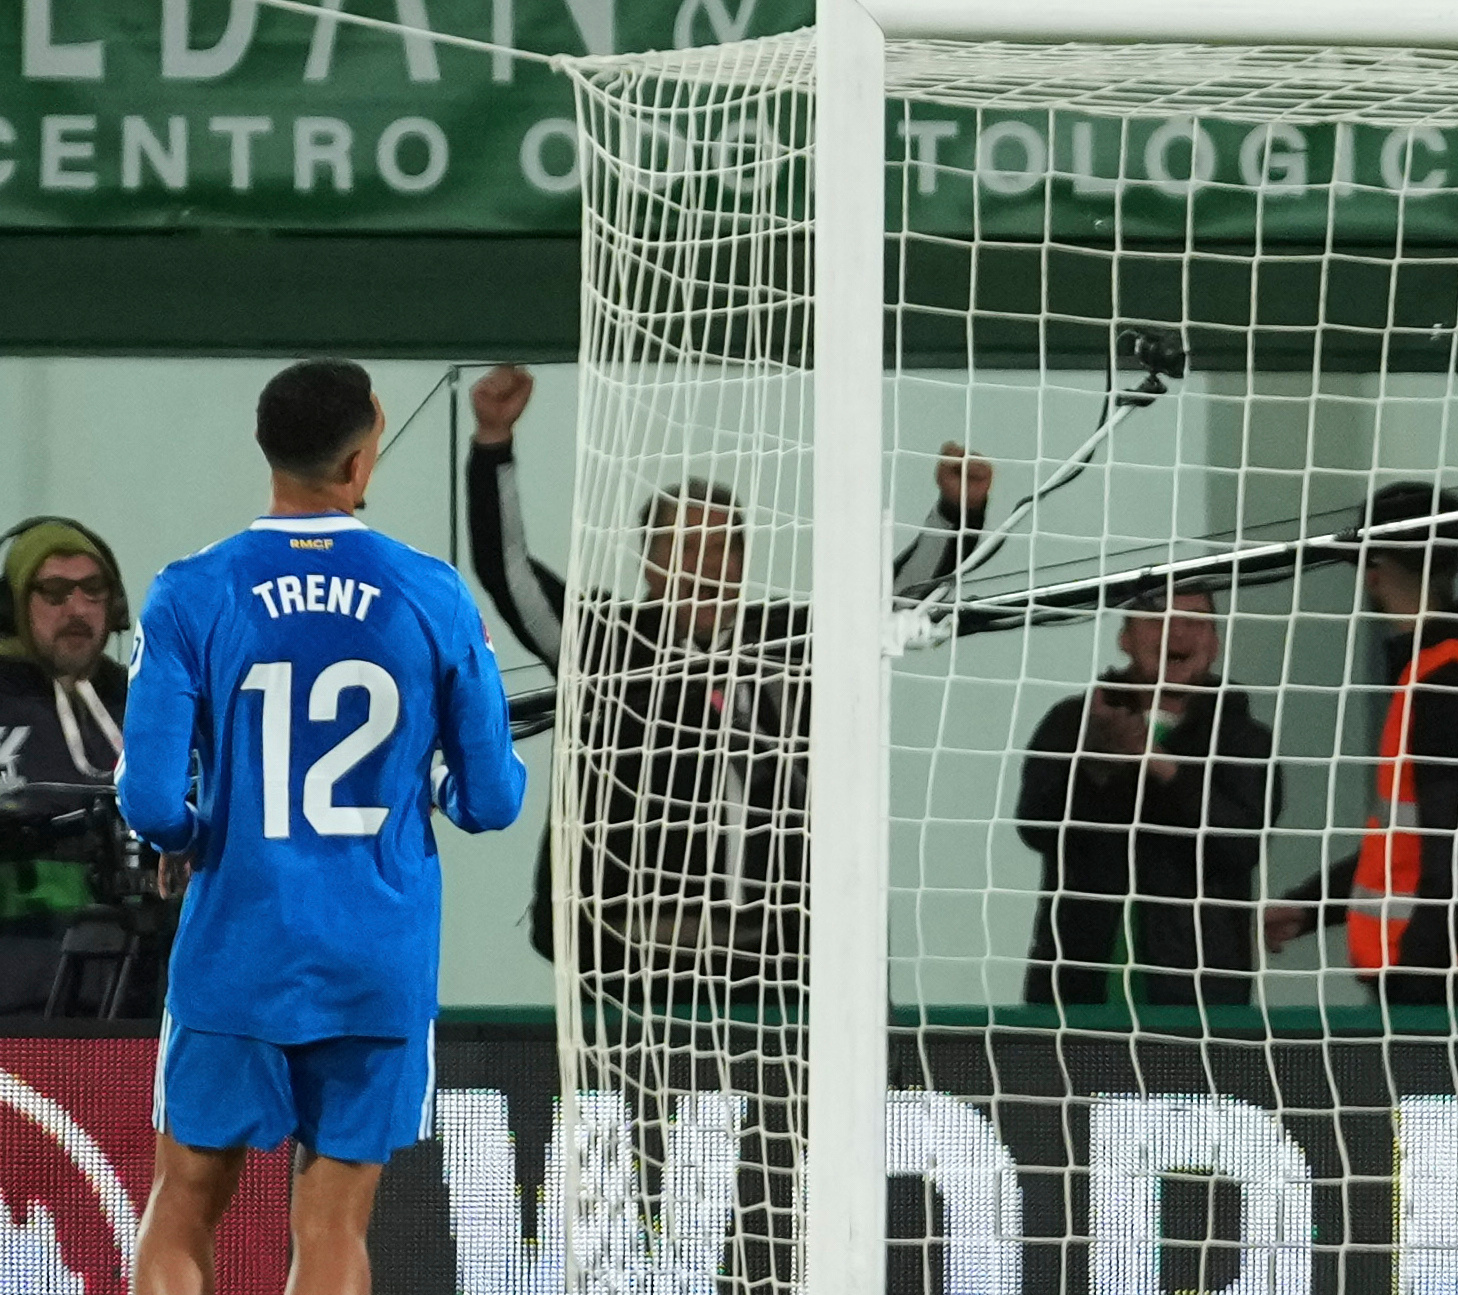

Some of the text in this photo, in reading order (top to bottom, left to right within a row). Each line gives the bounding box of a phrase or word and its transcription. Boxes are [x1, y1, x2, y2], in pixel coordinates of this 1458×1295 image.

[0, 114, 452, 194] ENTRO
[289, 537, 334, 550] RMCF
[252, 575, 381, 622] TRENT
[241, 660, 399, 838] 12
